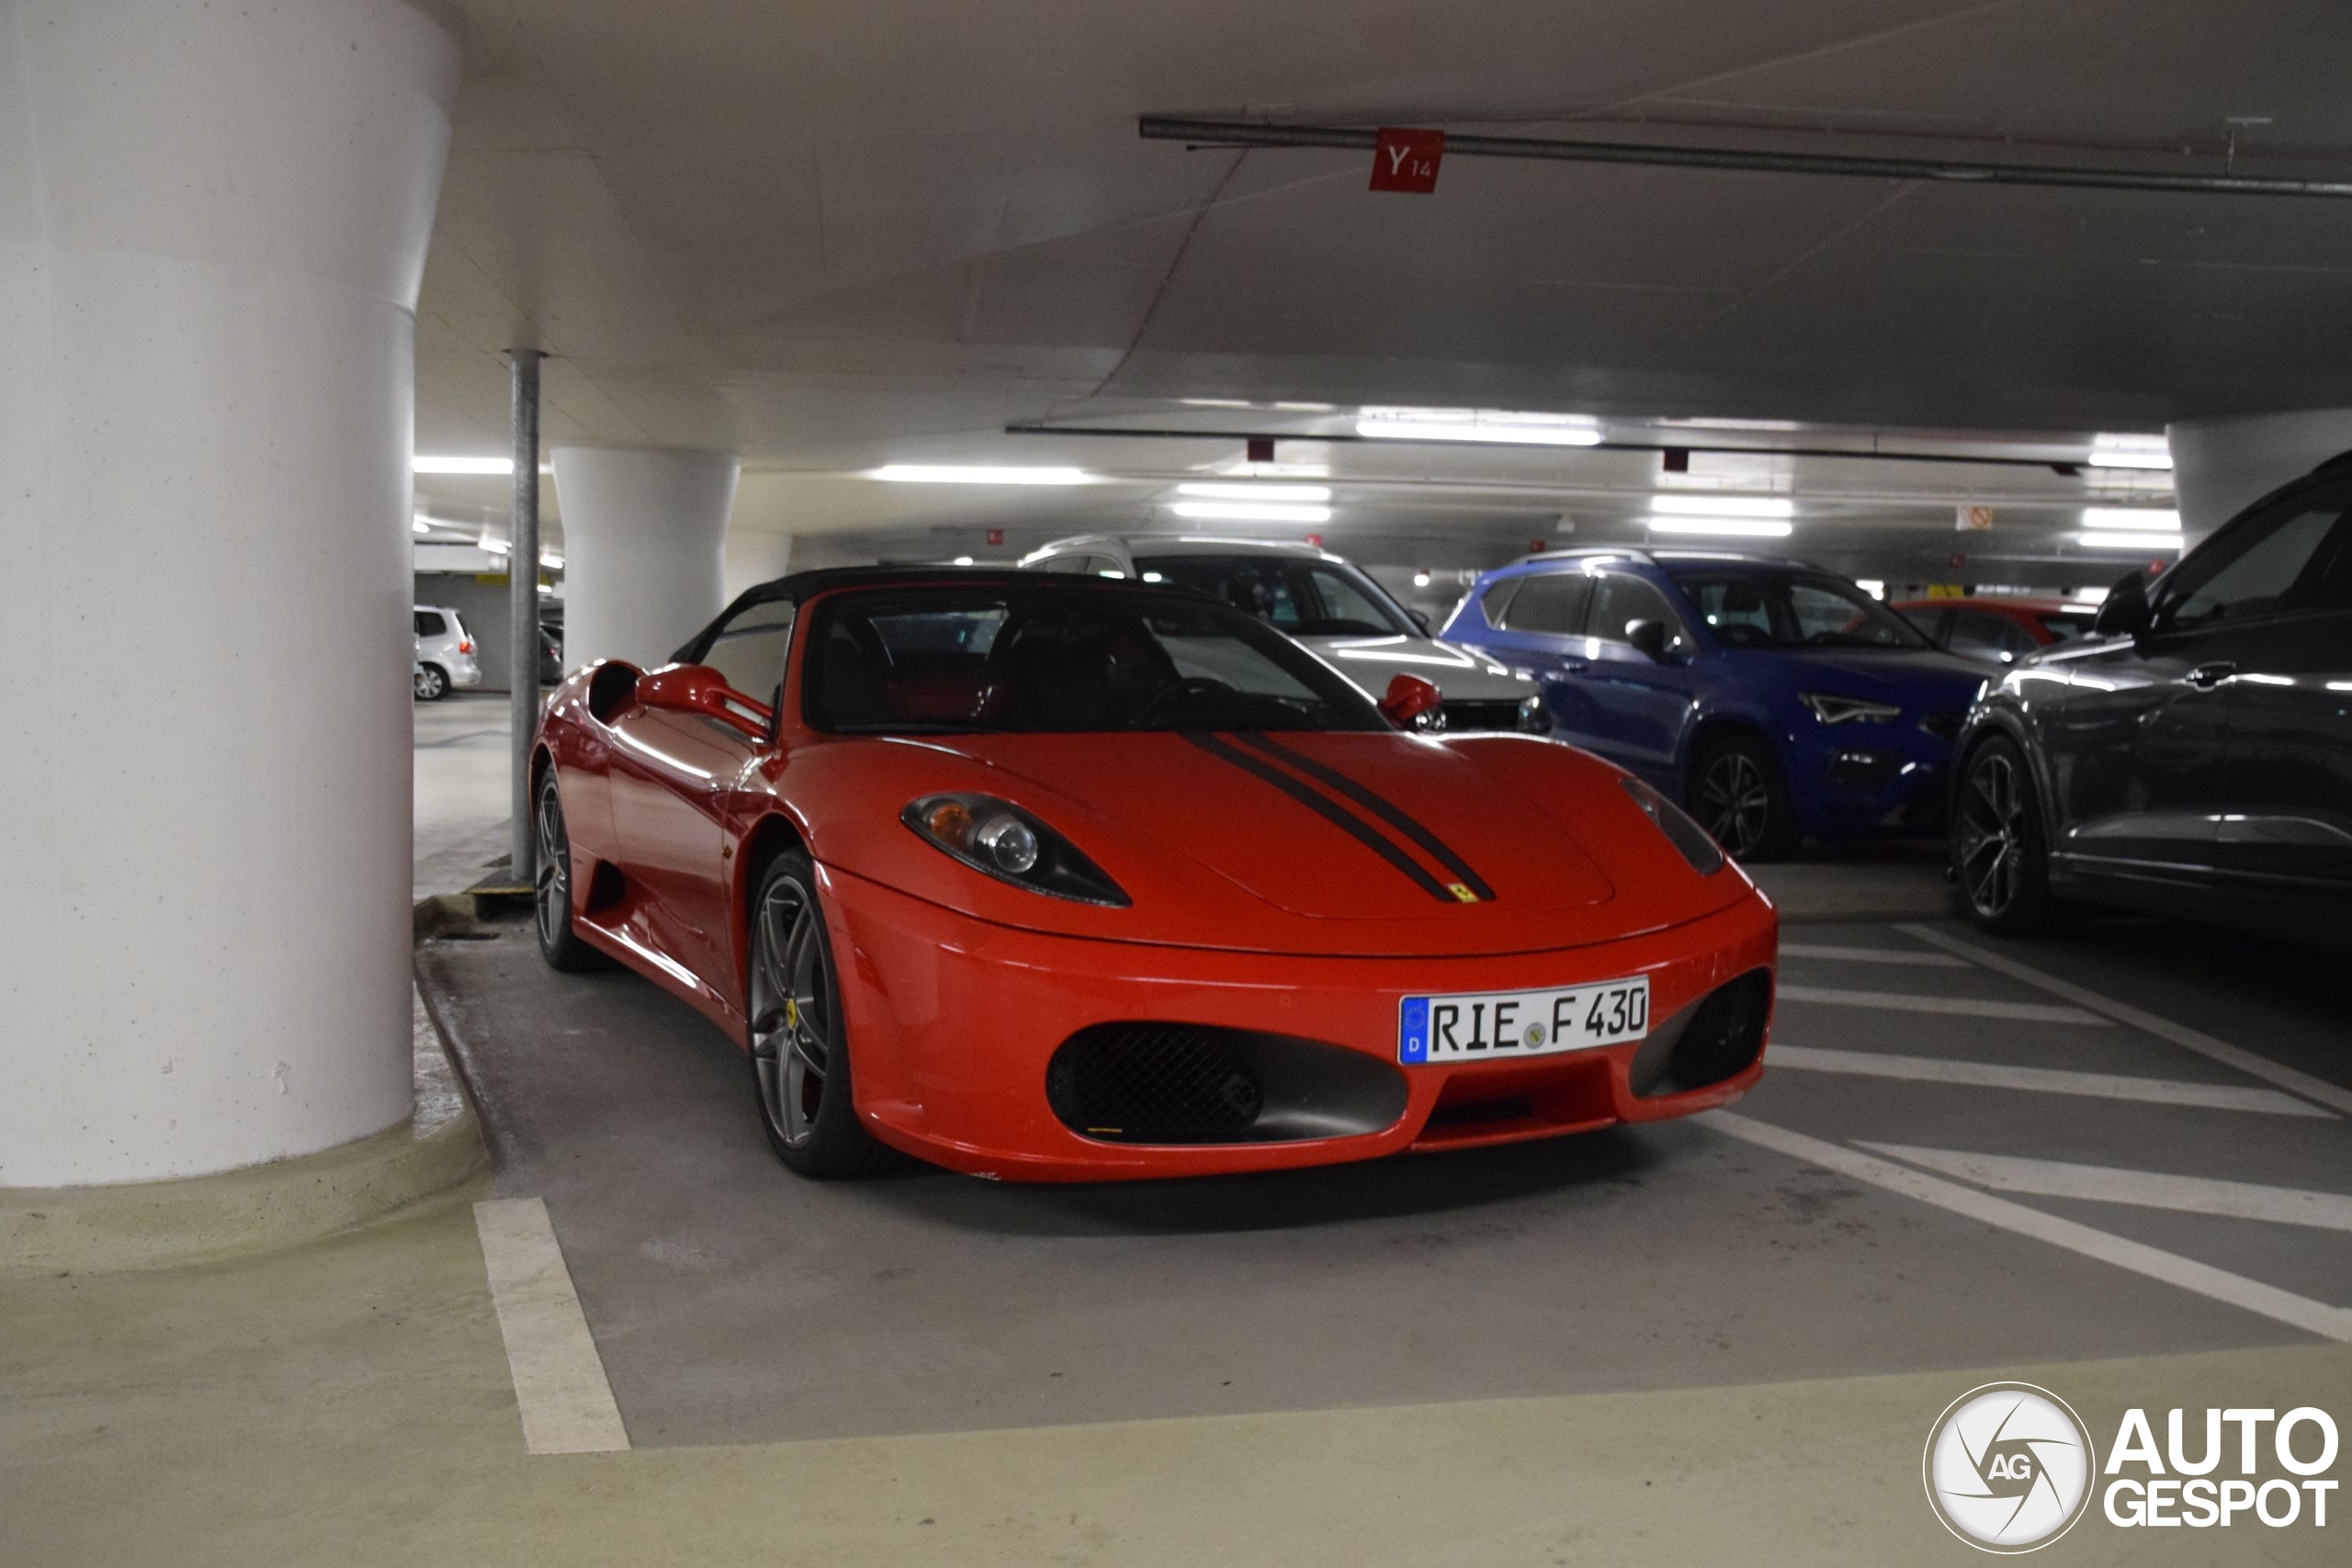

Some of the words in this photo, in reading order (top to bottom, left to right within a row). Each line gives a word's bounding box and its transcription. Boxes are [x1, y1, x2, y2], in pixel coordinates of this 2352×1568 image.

[1388, 145, 1410, 175] Y
[1412, 160, 1430, 177] 14
[1431, 1001, 1520, 1052] RIE
[1552, 996, 1577, 1043] F
[1585, 987, 1646, 1037] 430
[1408, 1037, 1420, 1053] D
